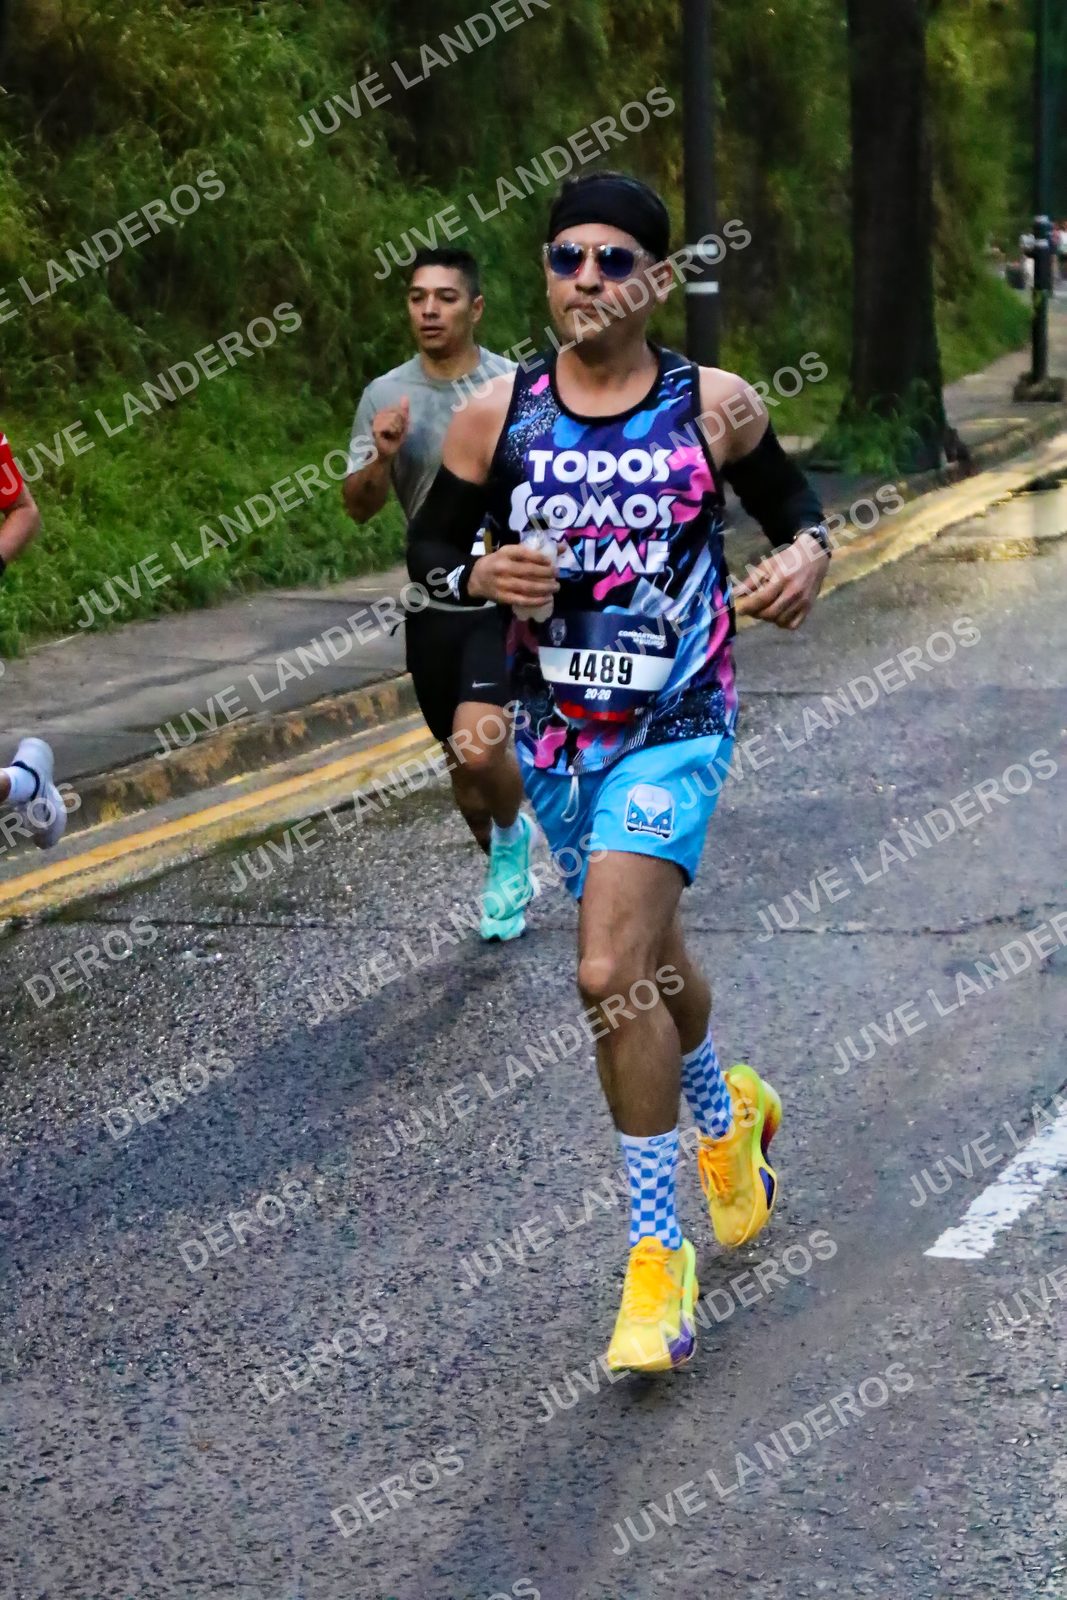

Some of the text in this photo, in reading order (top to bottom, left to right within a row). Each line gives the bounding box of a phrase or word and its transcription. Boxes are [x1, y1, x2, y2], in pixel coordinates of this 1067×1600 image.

[529, 449, 672, 483] TODOS
[526, 494, 677, 530] SOMOS
[568, 651, 633, 685] 4489
